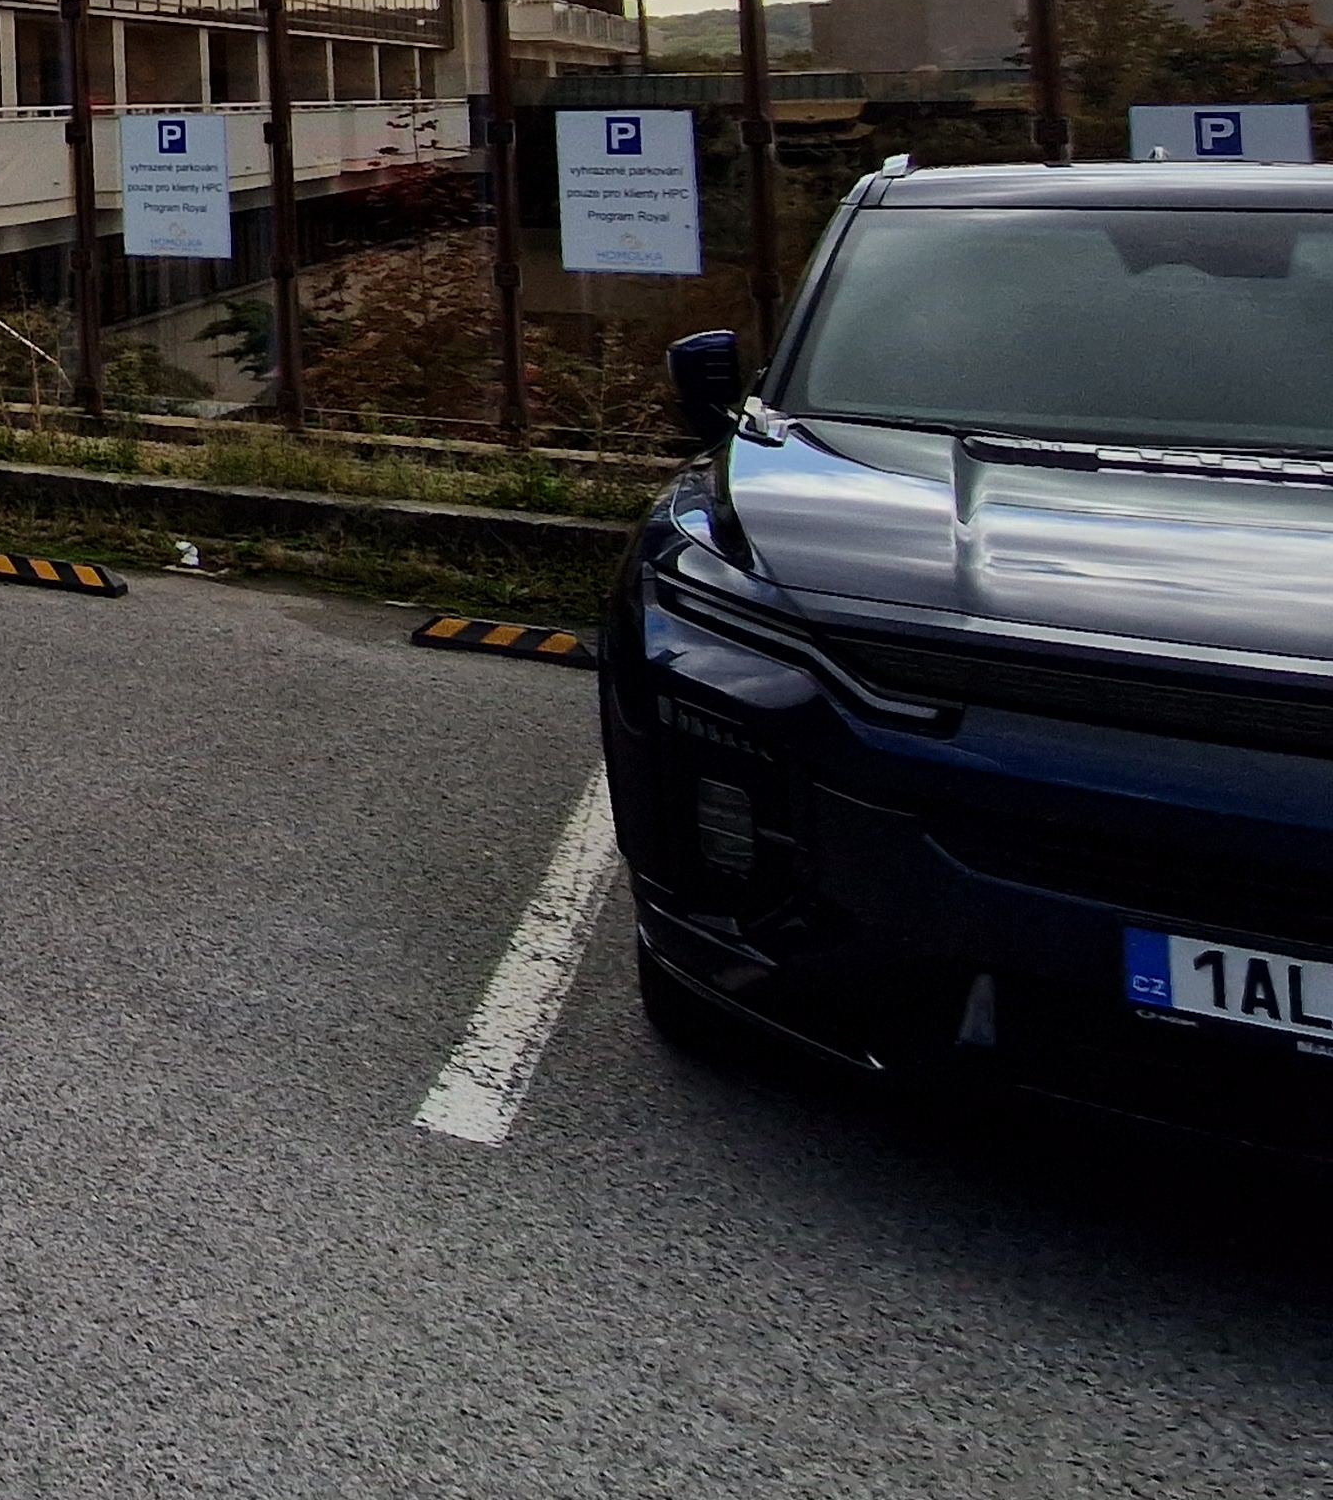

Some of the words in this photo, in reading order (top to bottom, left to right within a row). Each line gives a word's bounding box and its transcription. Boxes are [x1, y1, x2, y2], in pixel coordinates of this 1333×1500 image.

[162, 125, 182, 149] P
[610, 122, 636, 150] P
[1201, 117, 1235, 150] P
[130, 163, 173, 174] vyhrazené
[176, 163, 218, 173] parkování
[569, 166, 626, 178] vyhrazené
[628, 166, 684, 177] parkování
[127, 184, 153, 193] pouze
[155, 184, 170, 193] pro
[172, 183, 200, 194] klienty
[201, 183, 223, 192] HPC
[567, 189, 600, 199] pouze
[602, 190, 620, 199] pro
[623, 189, 659, 200] klienty
[662, 189, 690, 199] HPC
[143, 202, 180, 214] Program
[182, 203, 208, 214] Royal
[587, 210, 634, 223] Program
[637, 210, 670, 223] Royal
[597, 250, 662, 261] HOMOLKA
[1132, 974, 1168, 997] CZ
[1193, 949, 1332, 1030] 1AL
